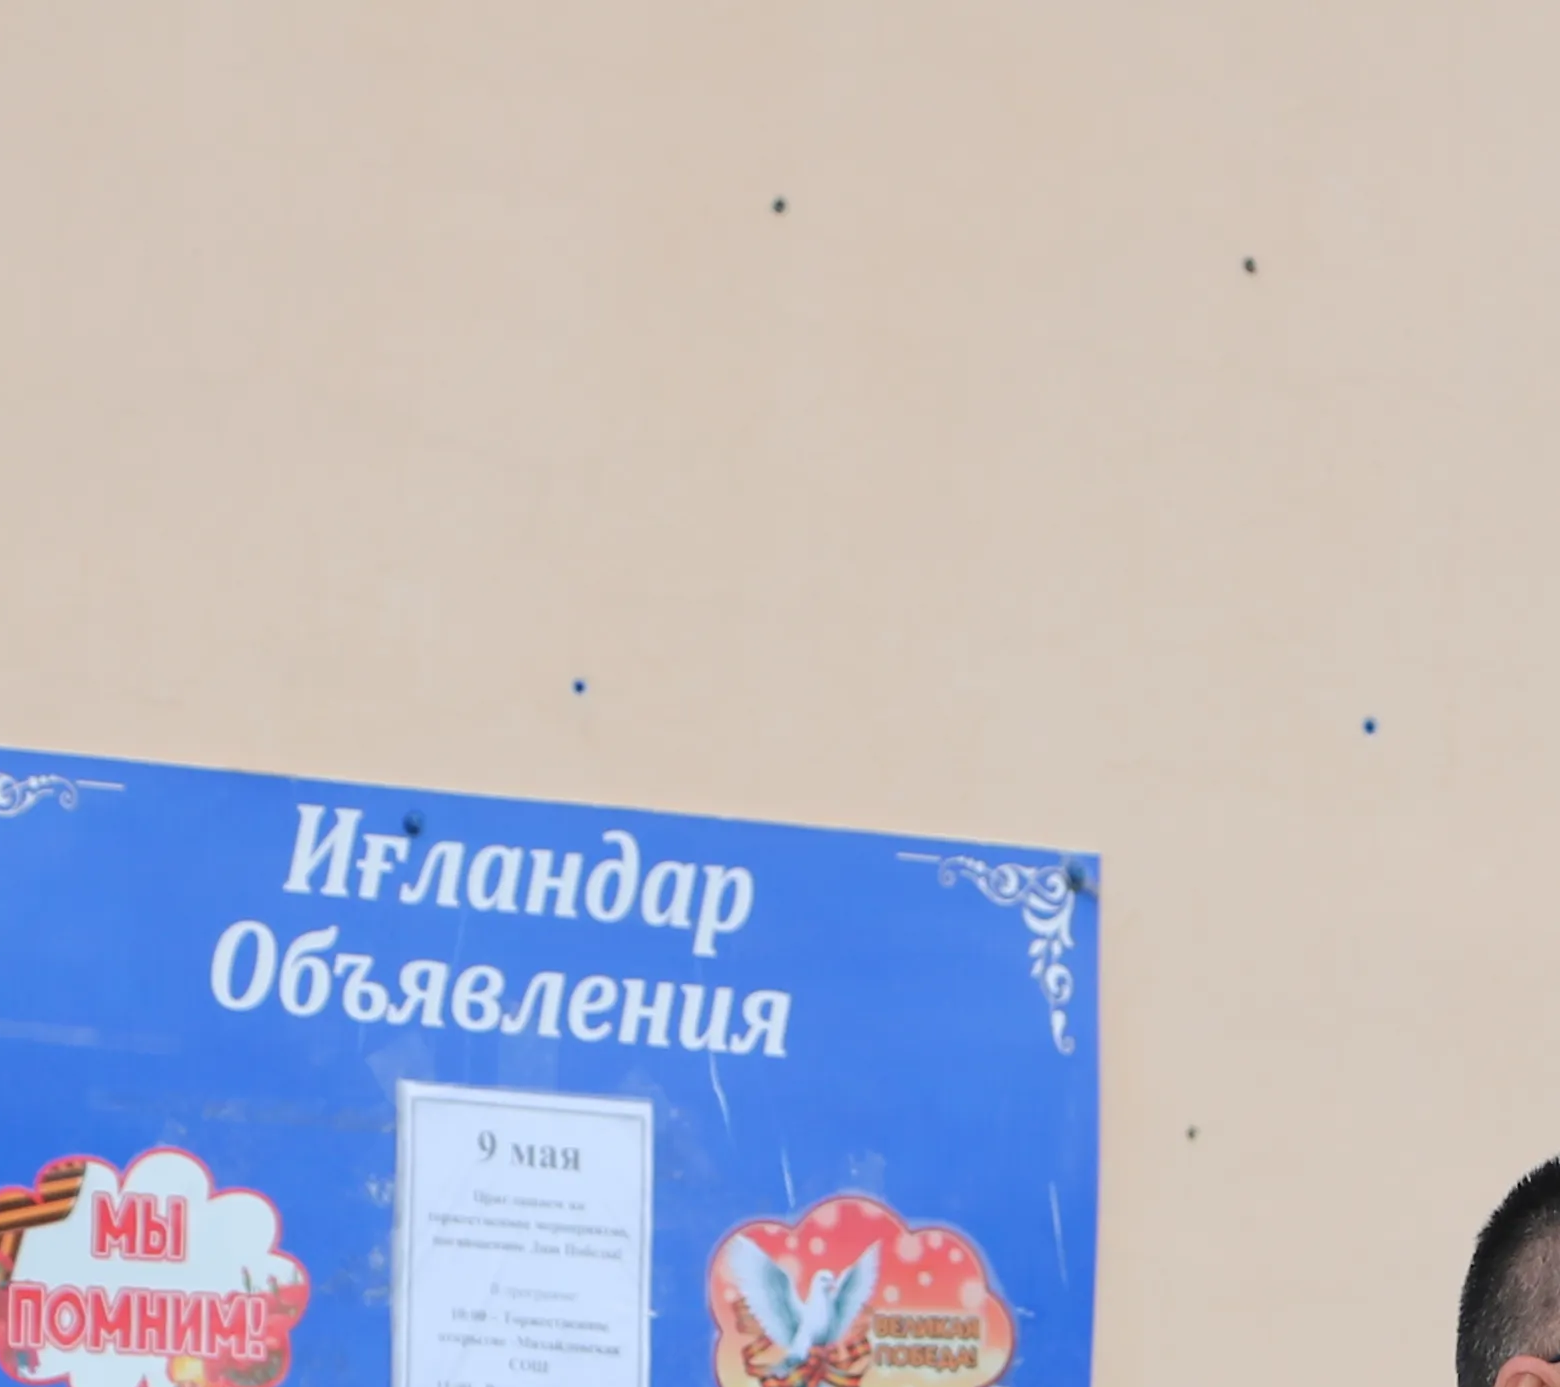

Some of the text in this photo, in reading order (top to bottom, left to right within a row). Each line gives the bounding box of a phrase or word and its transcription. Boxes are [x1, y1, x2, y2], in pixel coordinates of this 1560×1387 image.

[282, 802, 755, 958] Иғландар
[209, 919, 791, 1058] Объявления
[477, 1129, 581, 1172] 9 мая
[92, 1191, 188, 1262] МЫ
[8, 1281, 268, 1360] ПОМНИМ!
[874, 1313, 980, 1340] ВЕЛИКАЯ
